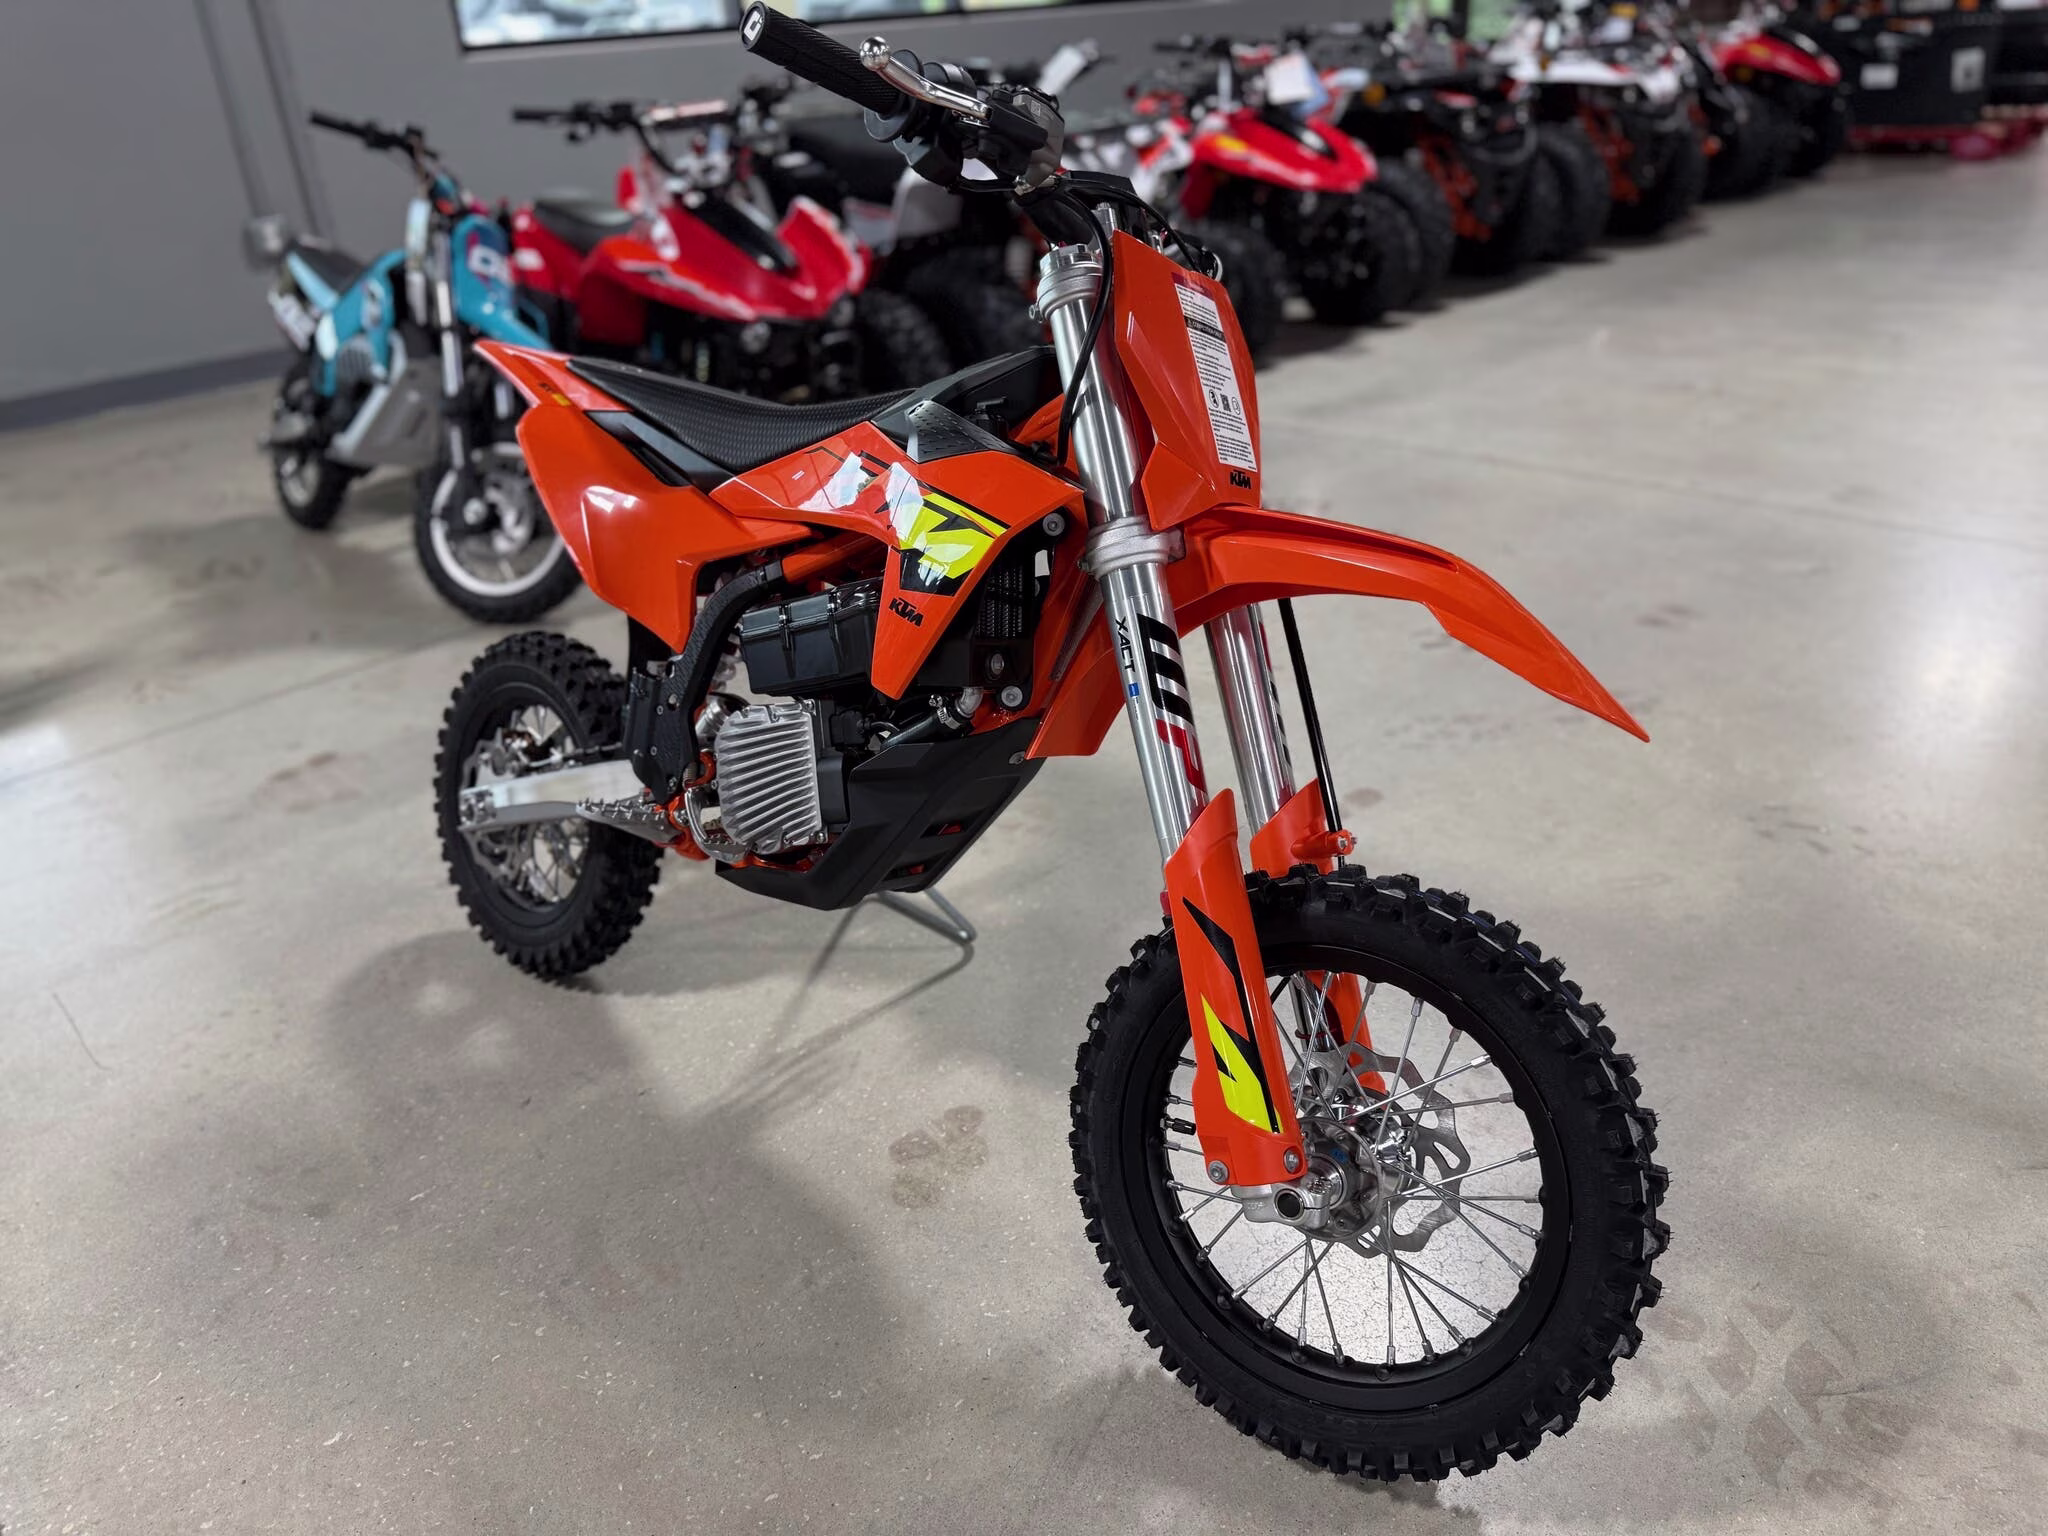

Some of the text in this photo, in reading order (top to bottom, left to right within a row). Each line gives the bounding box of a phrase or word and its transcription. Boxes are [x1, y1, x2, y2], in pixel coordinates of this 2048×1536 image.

[1230, 469, 1251, 489] KTM
[889, 597, 924, 627] KTM
[1115, 616, 1136, 673] XACT
